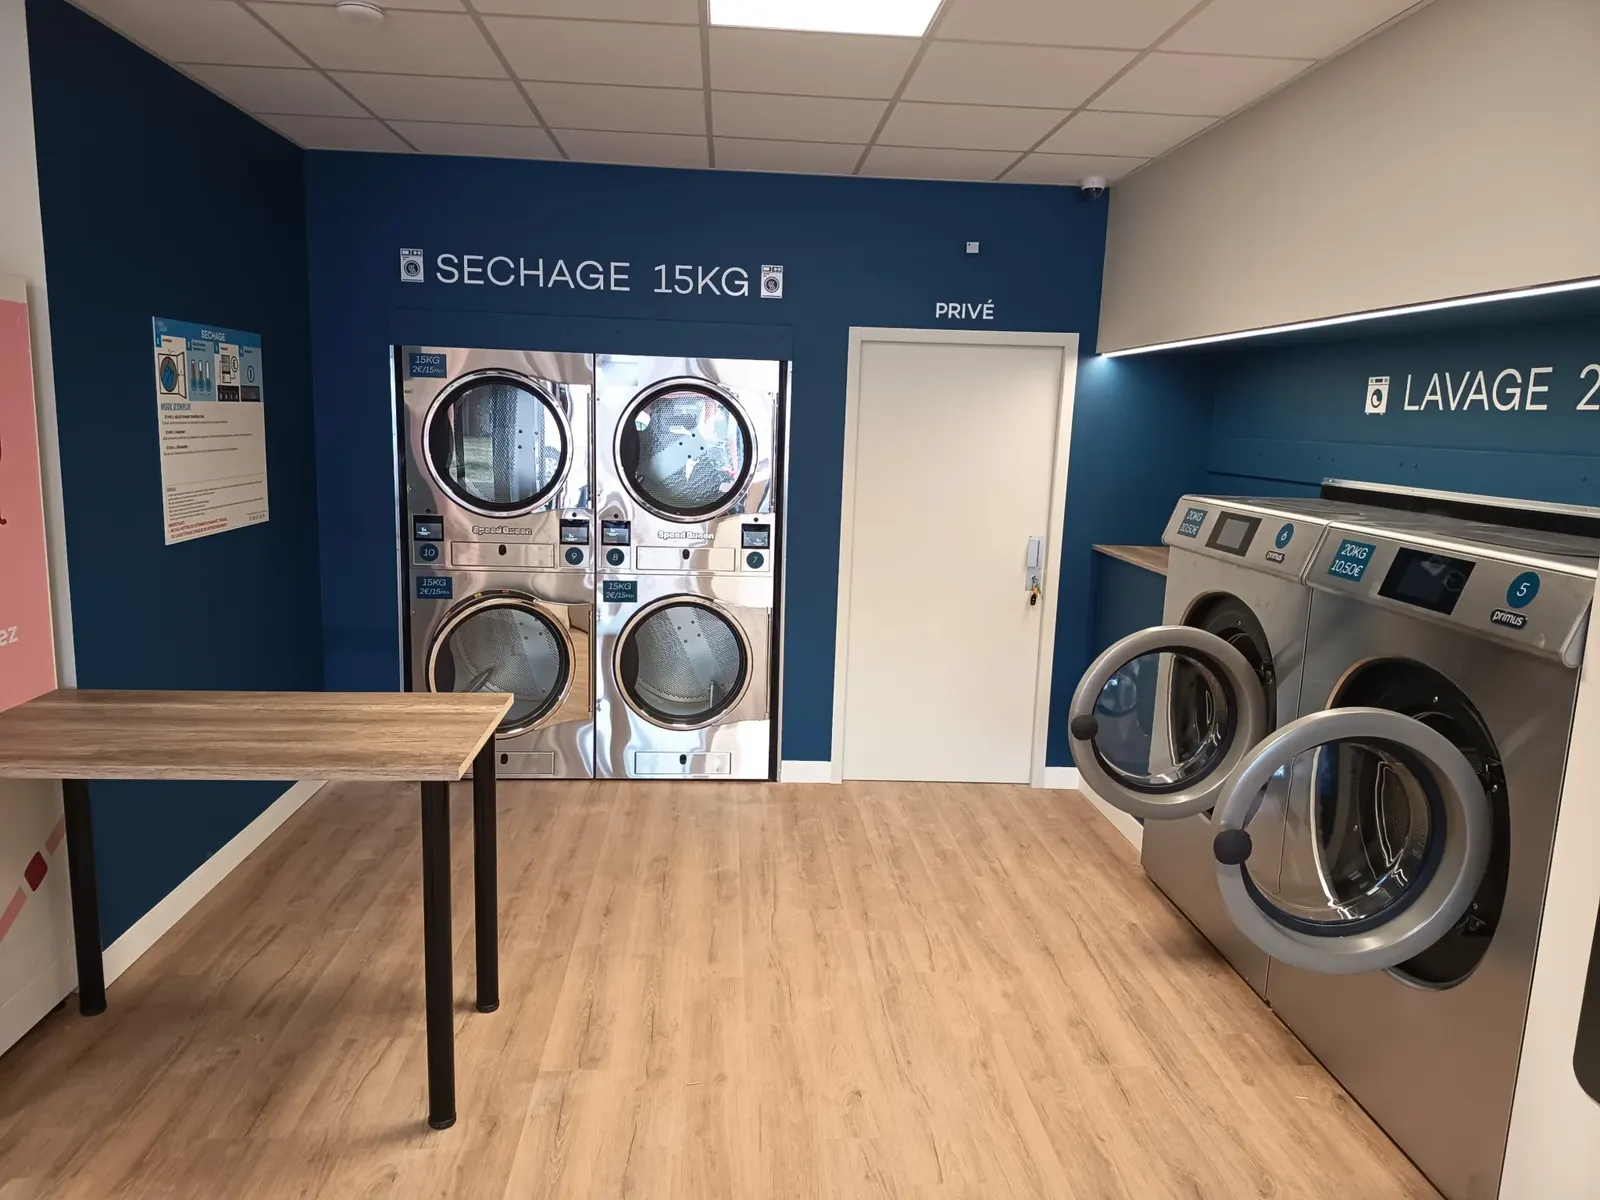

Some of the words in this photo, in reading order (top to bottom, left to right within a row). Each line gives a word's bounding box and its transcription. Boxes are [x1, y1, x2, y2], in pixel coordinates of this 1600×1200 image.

[436, 253, 631, 292] SECHAGE
[653, 264, 749, 297] 15KG
[935, 299, 995, 320] PRIVÉ
[415, 355, 441, 364] 15KG
[1403, 366, 1553, 412] LAVAGE
[657, 530, 687, 541] Speed
[686, 530, 716, 541] Queen
[1280, 530, 1289, 541] 6
[423, 548, 436, 557] 10
[571, 552, 578, 560] 9
[1341, 543, 1369, 559] 20KG
[612, 553, 619, 561] 8
[752, 556, 759, 564] 7
[1330, 559, 1364, 577] 10,50€
[422, 578, 447, 587] 15KG
[608, 582, 632, 590] 15KG
[1516, 582, 1531, 597] 5
[1492, 610, 1524, 627] primus
